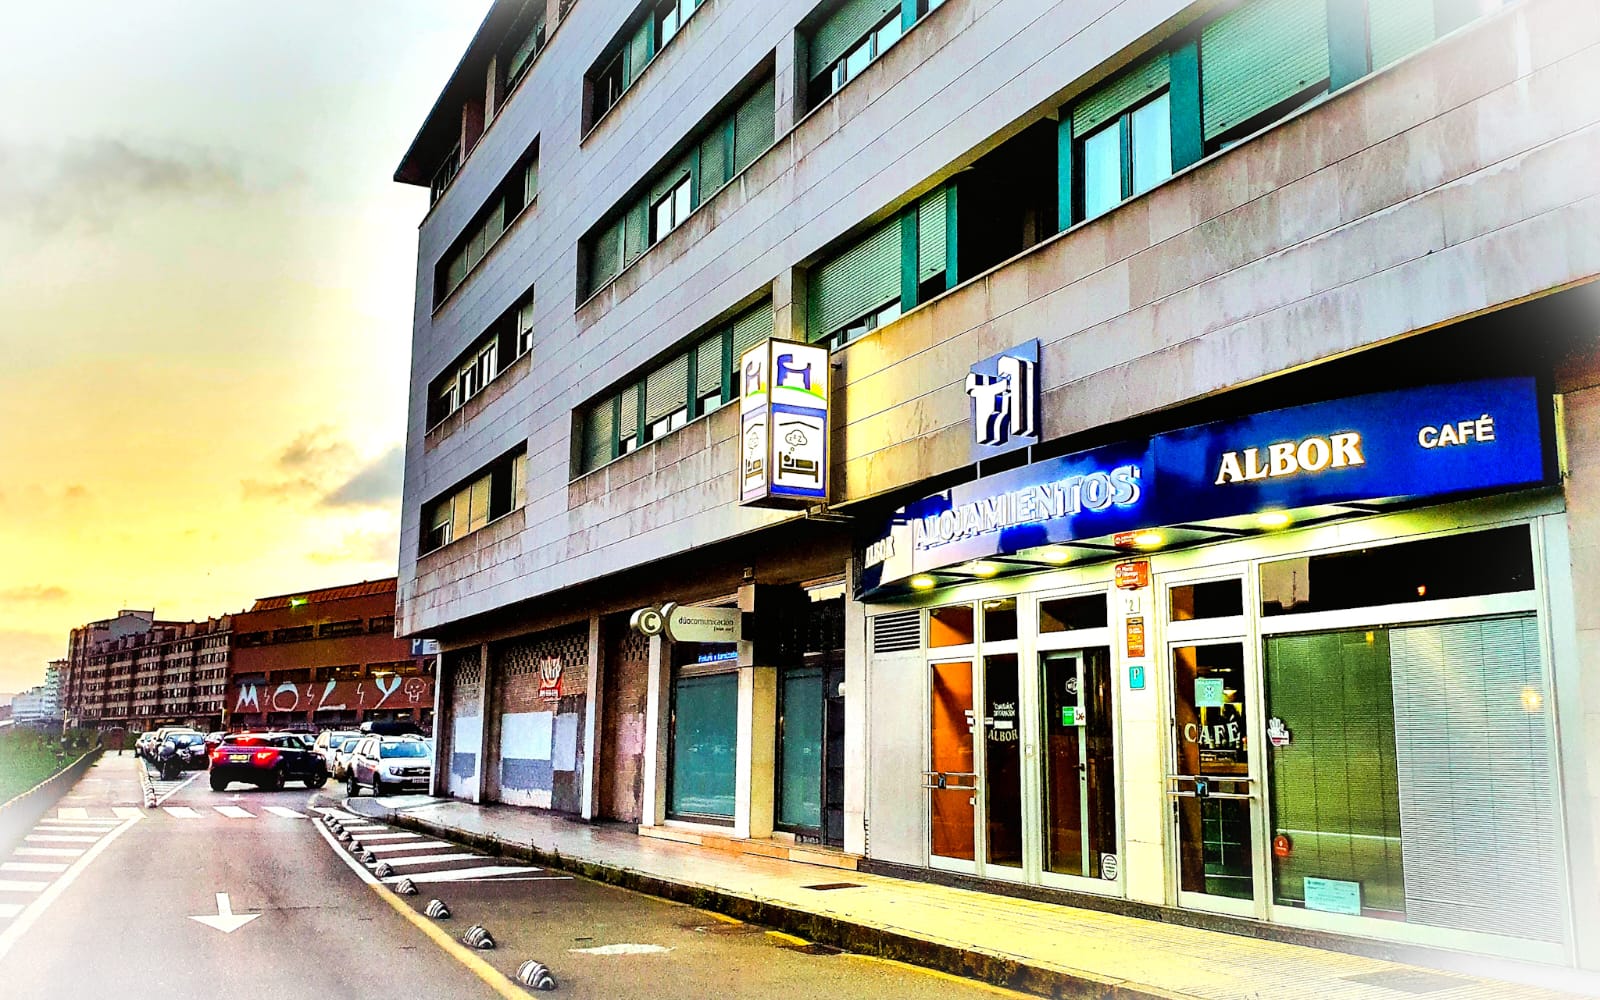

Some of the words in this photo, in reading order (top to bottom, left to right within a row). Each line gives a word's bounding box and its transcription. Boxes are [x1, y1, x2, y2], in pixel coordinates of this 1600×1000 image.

[1418, 413, 1495, 448] CAFÉ
[1214, 431, 1365, 485] ALBOR
[914, 464, 1141, 550] ALOJAMIENTOS
[987, 729, 1019, 742] ALBOR
[1184, 714, 1241, 745] CAFÉ
